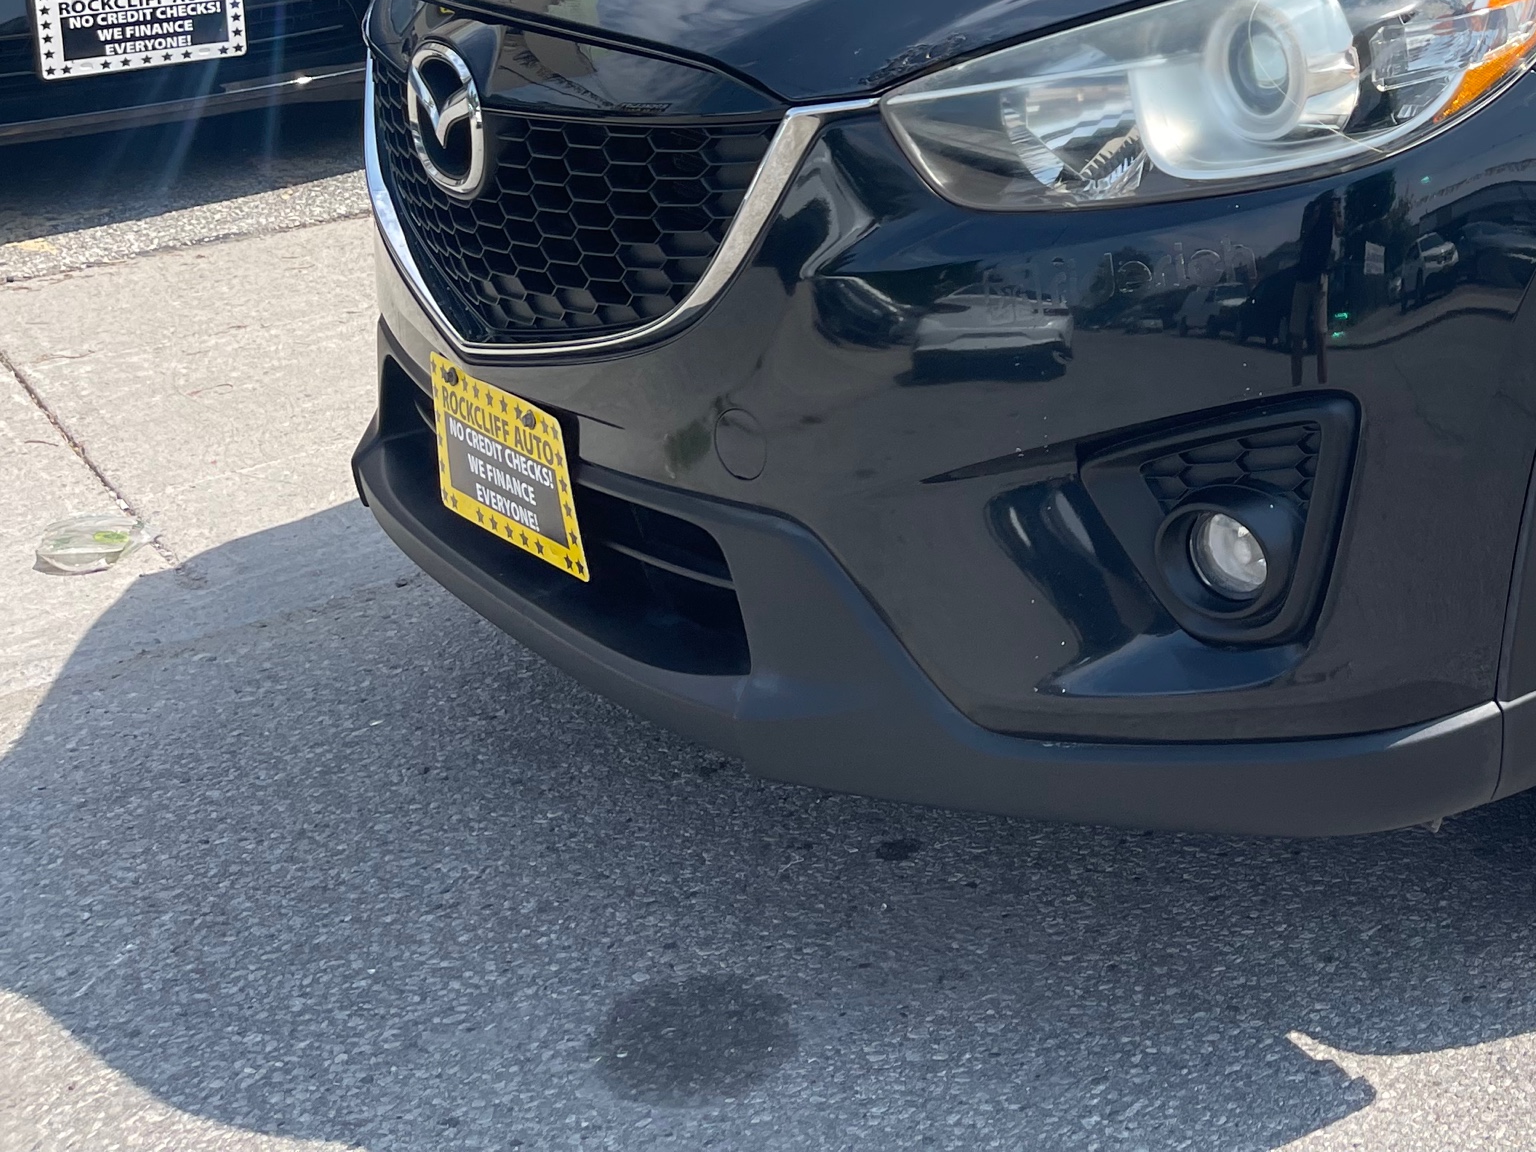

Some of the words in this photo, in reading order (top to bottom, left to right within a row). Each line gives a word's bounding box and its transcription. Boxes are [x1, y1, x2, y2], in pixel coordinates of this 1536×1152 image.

[69, 15, 94, 29] NO
[96, 9, 153, 26] CREDIT
[156, 1, 222, 20] CHECKS!
[97, 28, 122, 41] WE
[125, 20, 194, 39] FINANCE
[105, 35, 192, 56] EVERYONE!
[442, 385, 509, 443] ROCKCLIFF
[514, 426, 554, 466] AUTO
[449, 417, 464, 441] NO
[466, 425, 503, 462] CREDIT
[504, 448, 554, 489] CHECKS!
[467, 453, 486, 479] WE
[487, 464, 537, 506] FINANCE
[476, 483, 540, 532] EVERYONE!
